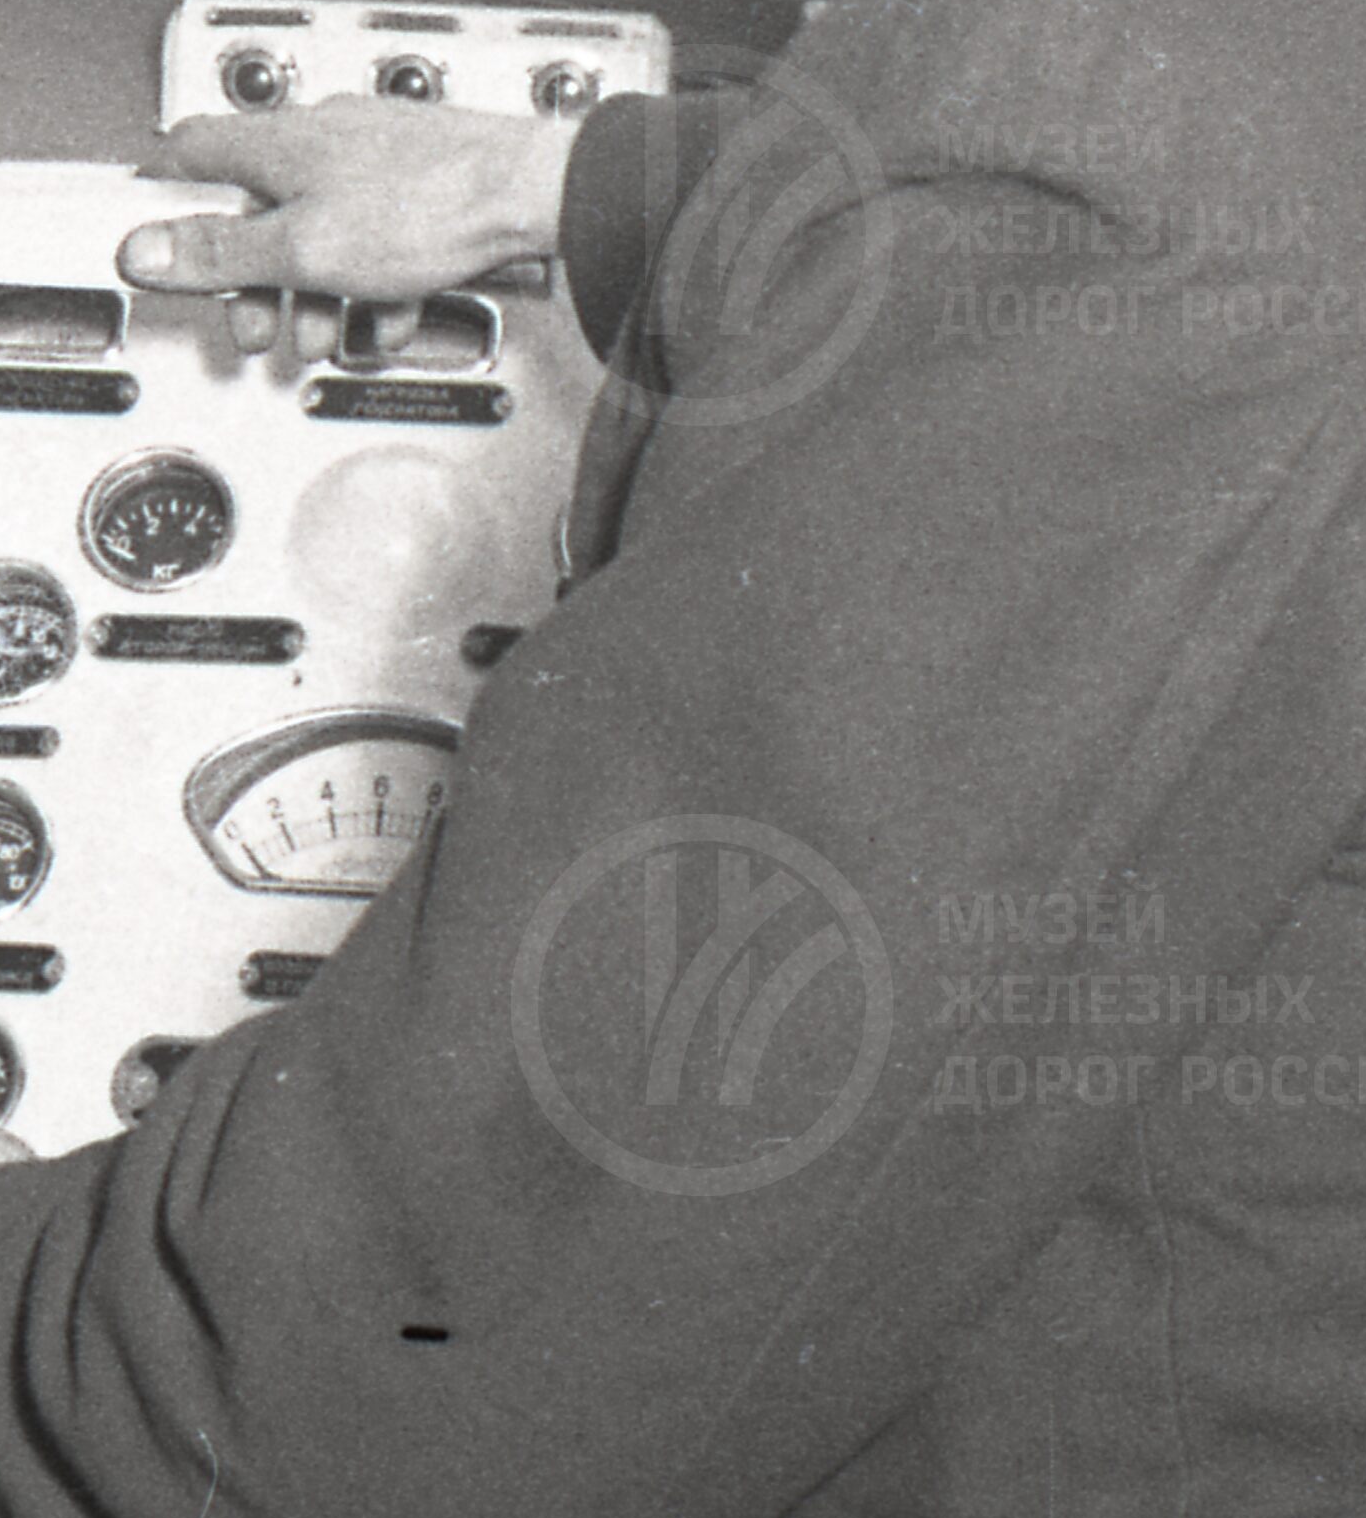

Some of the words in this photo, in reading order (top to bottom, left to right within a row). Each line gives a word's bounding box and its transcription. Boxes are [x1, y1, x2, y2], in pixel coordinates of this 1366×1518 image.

[320, 780, 334, 800] 4
[374, 775, 390, 798] 6
[426, 782, 443, 806] 8
[266, 796, 285, 820] 2
